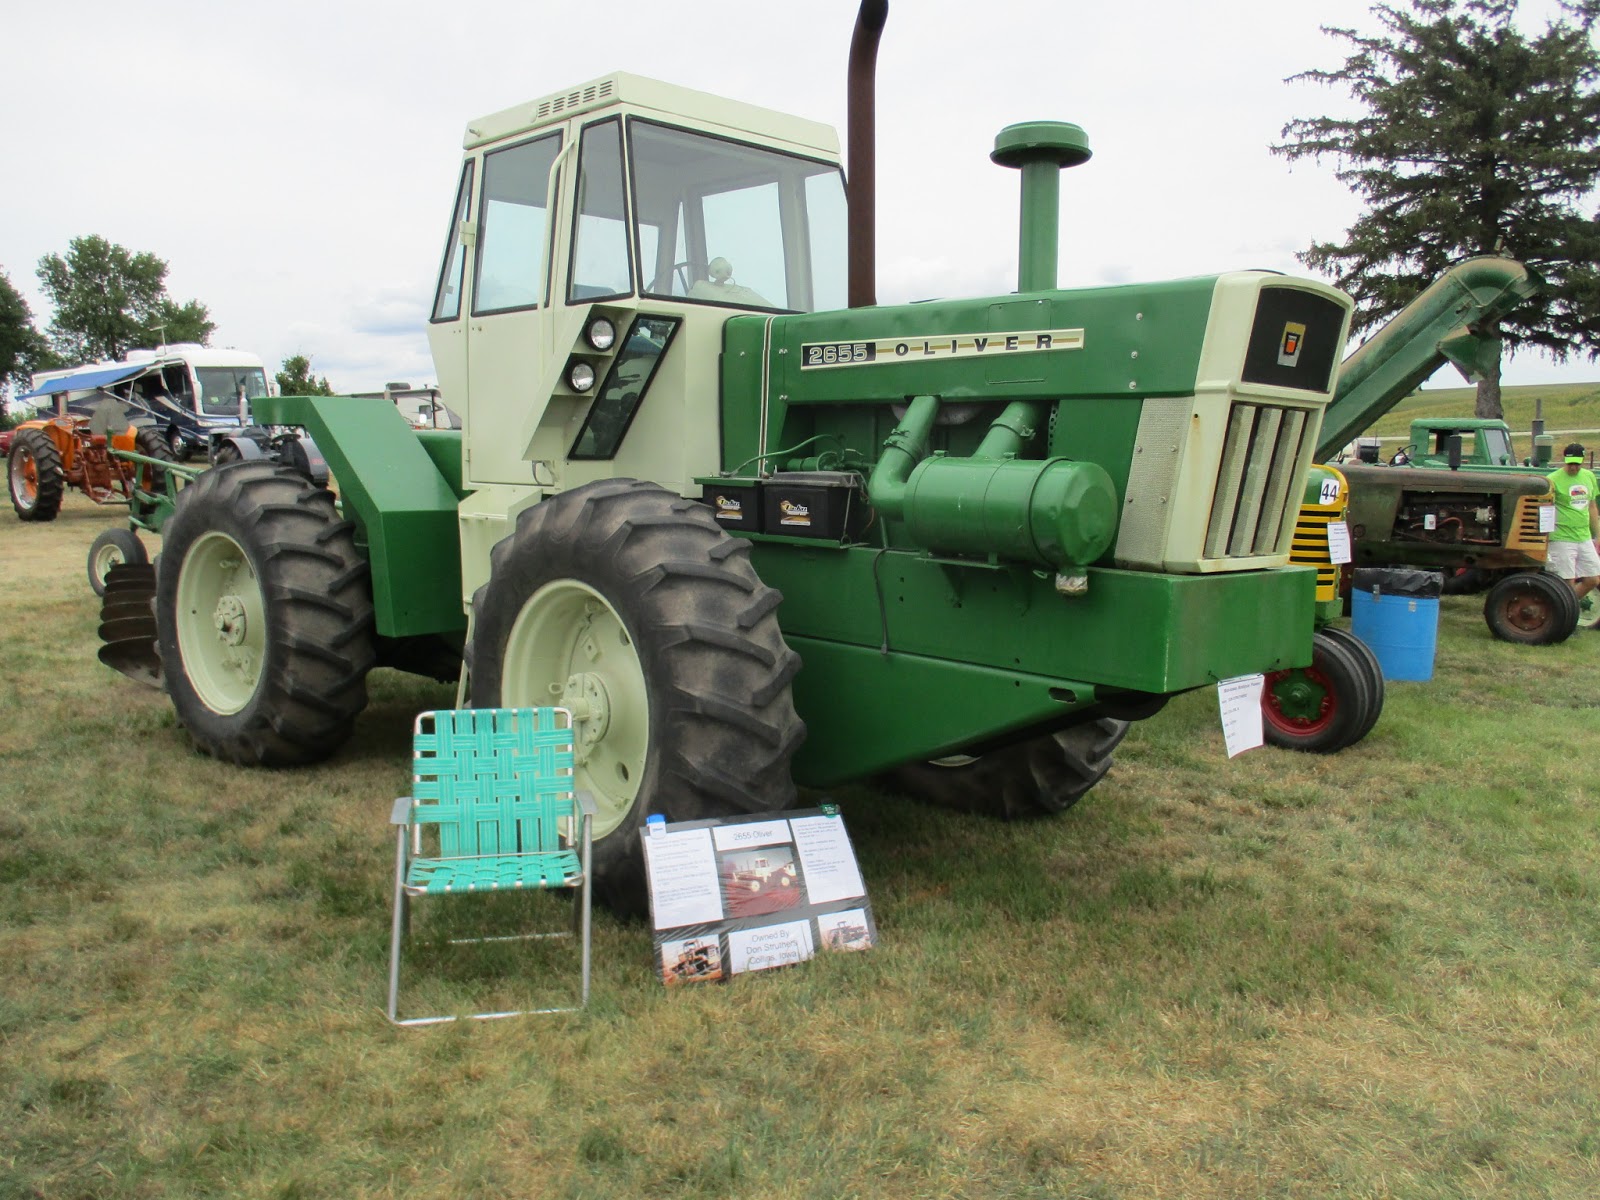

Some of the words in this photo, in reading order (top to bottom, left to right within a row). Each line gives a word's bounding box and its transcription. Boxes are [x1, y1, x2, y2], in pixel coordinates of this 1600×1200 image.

[808, 343, 868, 365] 2655
[895, 334, 1053, 357] OLIVER
[1321, 483, 1339, 501] 44
[733, 831, 751, 841] 2655
[752, 830, 773, 839] Oliver
[751, 933, 778, 943] Owned
[779, 929, 790, 940] By
[746, 945, 762, 955] Don
[779, 949, 797, 960] Iowa
